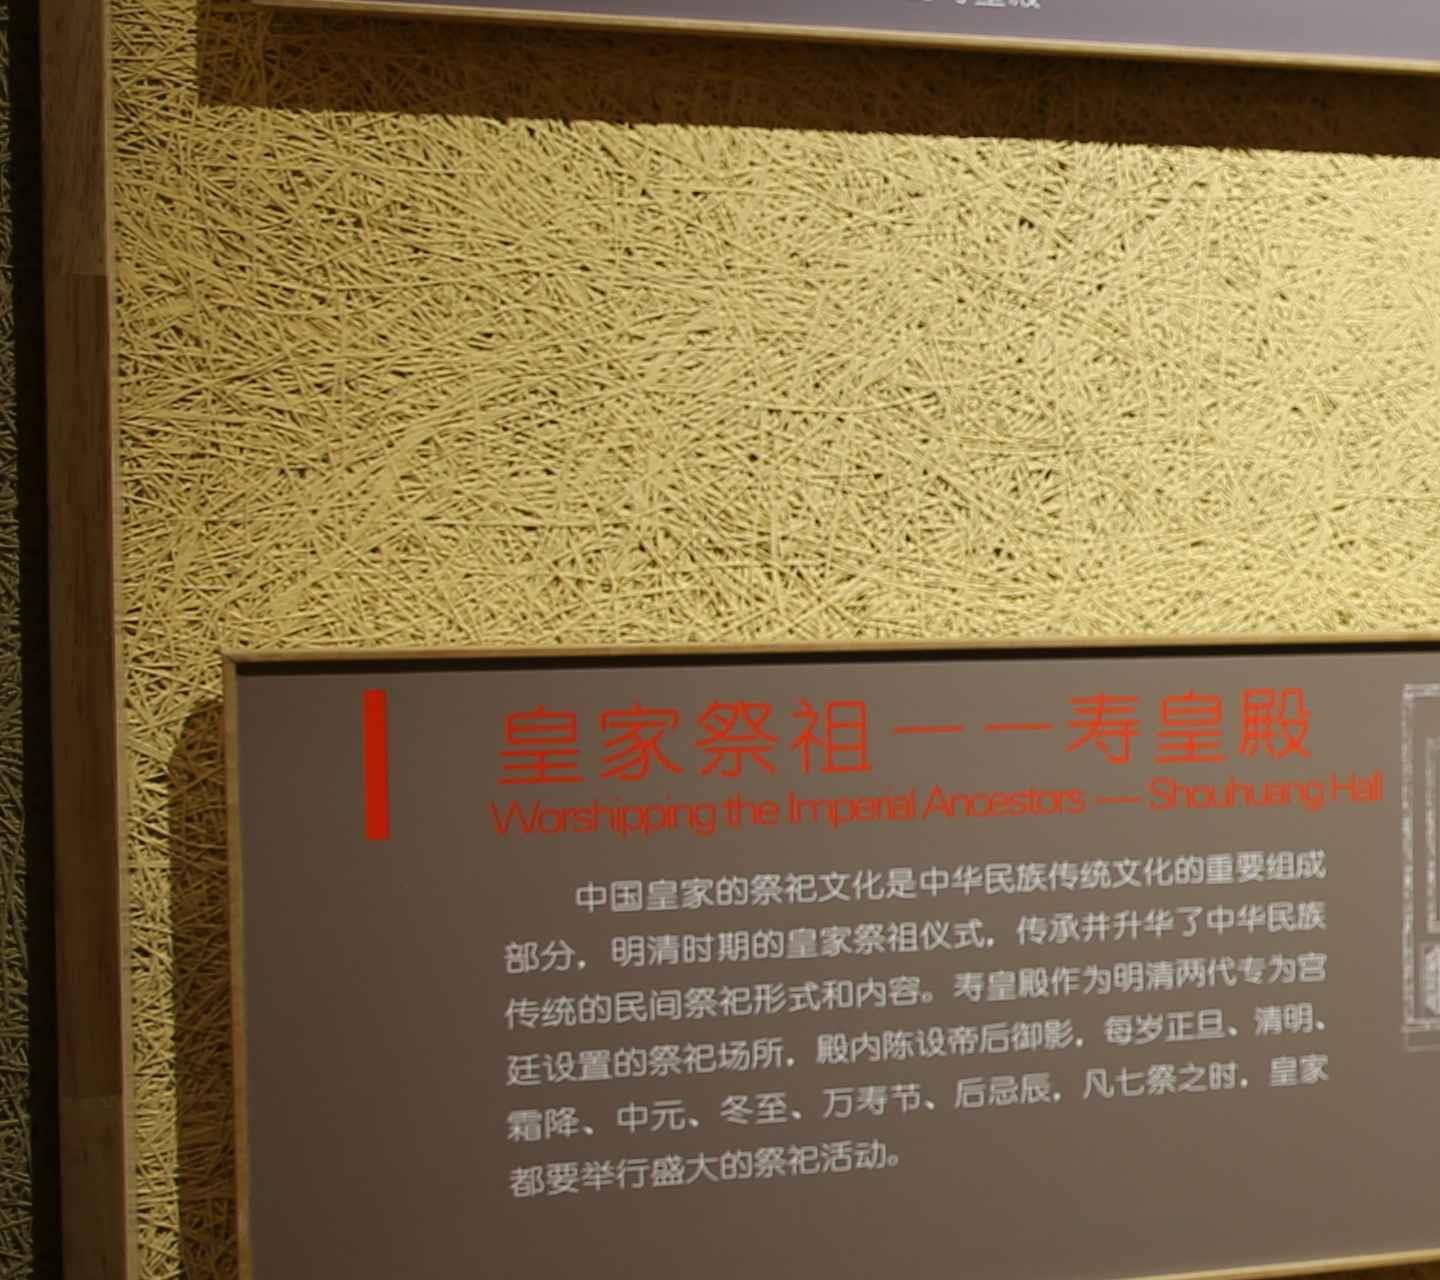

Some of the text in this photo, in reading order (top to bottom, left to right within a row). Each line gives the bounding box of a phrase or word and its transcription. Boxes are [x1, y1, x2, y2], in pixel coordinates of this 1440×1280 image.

[487, 798, 718, 838] Worshipping
[720, 792, 781, 828] the
[786, 789, 917, 829] Imperial
[921, 784, 1090, 819] Ancestors
[1328, 768, 1385, 805] Hall
